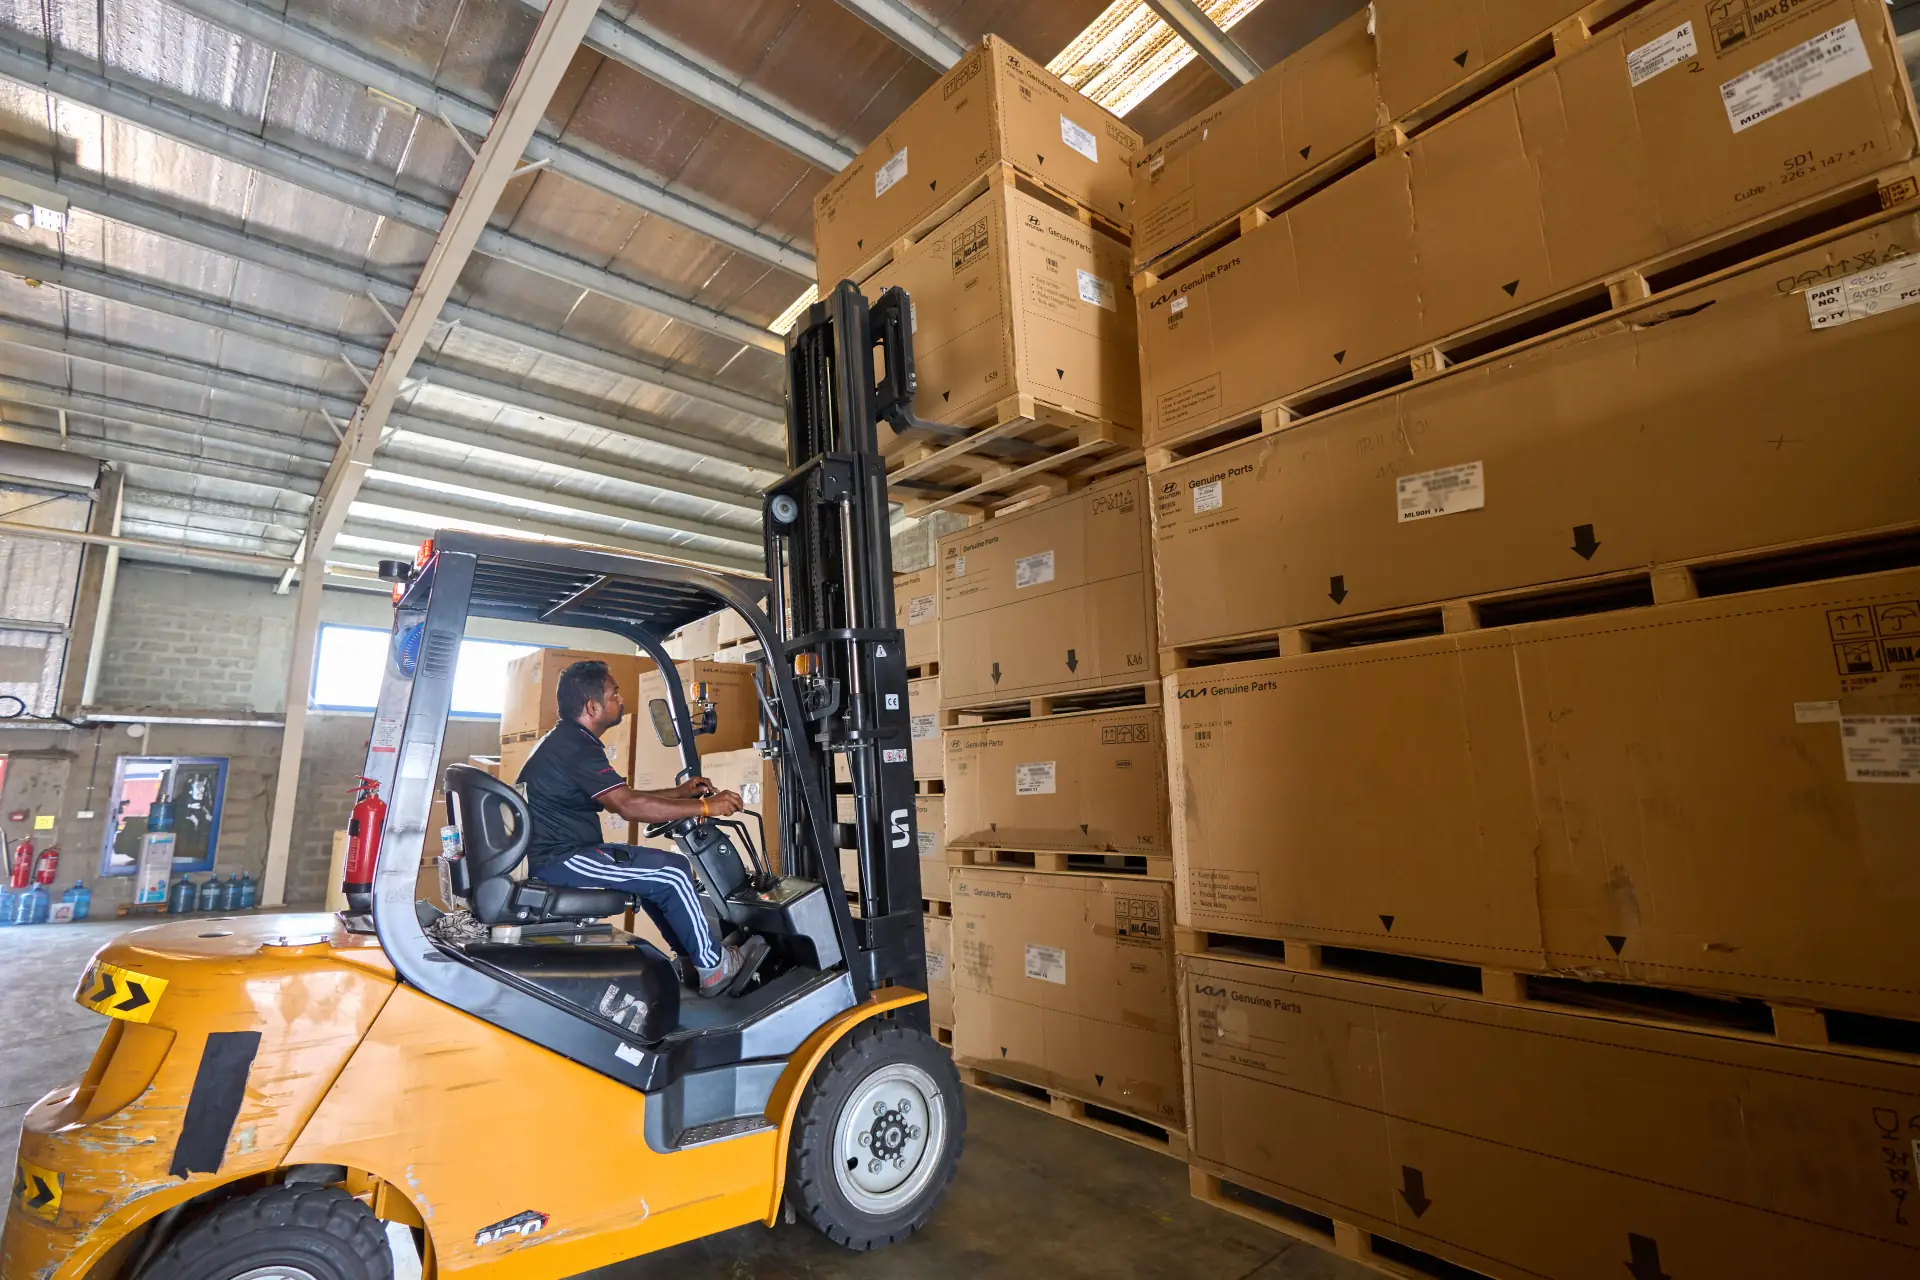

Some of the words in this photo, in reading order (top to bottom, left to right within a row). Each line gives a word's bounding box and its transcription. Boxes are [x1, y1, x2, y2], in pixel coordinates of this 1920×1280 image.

[1752, 4, 1779, 25] MAX
[1779, 0, 1790, 14] 8
[1676, 26, 1690, 39] AE
[1677, 53, 1689, 63] KIA
[1686, 61, 1705, 74] 2
[1026, 70, 1053, 92] Genuine
[1052, 87, 1069, 103] Parts
[1136, 146, 1163, 169] KIA
[1164, 125, 1199, 150] Genuine
[1200, 110, 1223, 129] Parts
[1783, 150, 1815, 171] SD1
[832, 175, 852, 195] Genuine
[851, 164, 864, 178] Parts
[1734, 185, 1766, 203] Cube
[1780, 169, 1806, 185] 226
[1819, 152, 1844, 168] 147
[1861, 140, 1876, 153] 71
[1048, 227, 1076, 246] Genuine
[1075, 240, 1092, 254] Parts
[1149, 288, 1178, 310] KIA
[1180, 269, 1216, 294] Genuine
[1216, 257, 1241, 276] Parts
[1811, 286, 1842, 301] PART
[1817, 297, 1839, 307] NO.
[1817, 311, 1845, 323] Q'TY
[1188, 472, 1226, 490] Genuine
[1228, 464, 1254, 478] Parts
[962, 541, 985, 553] Genuine
[984, 535, 999, 547] Parts
[909, 576, 921, 585] Parts
[1126, 652, 1143, 667] KA6
[1886, 646, 1914, 663] MAX
[1177, 687, 1207, 700] KIA
[1210, 684, 1249, 696] Genuine
[1251, 680, 1278, 692] Parts
[887, 697, 897, 707] CE
[965, 741, 988, 749] Genuine
[988, 739, 1004, 748] Parts
[973, 888, 996, 898] Genuine
[996, 891, 1012, 900] Parts
[1139, 922, 1148, 936] 4
[1195, 983, 1227, 998] KIA
[1231, 991, 1272, 1008] Genuine
[1273, 998, 1302, 1014] Parts
